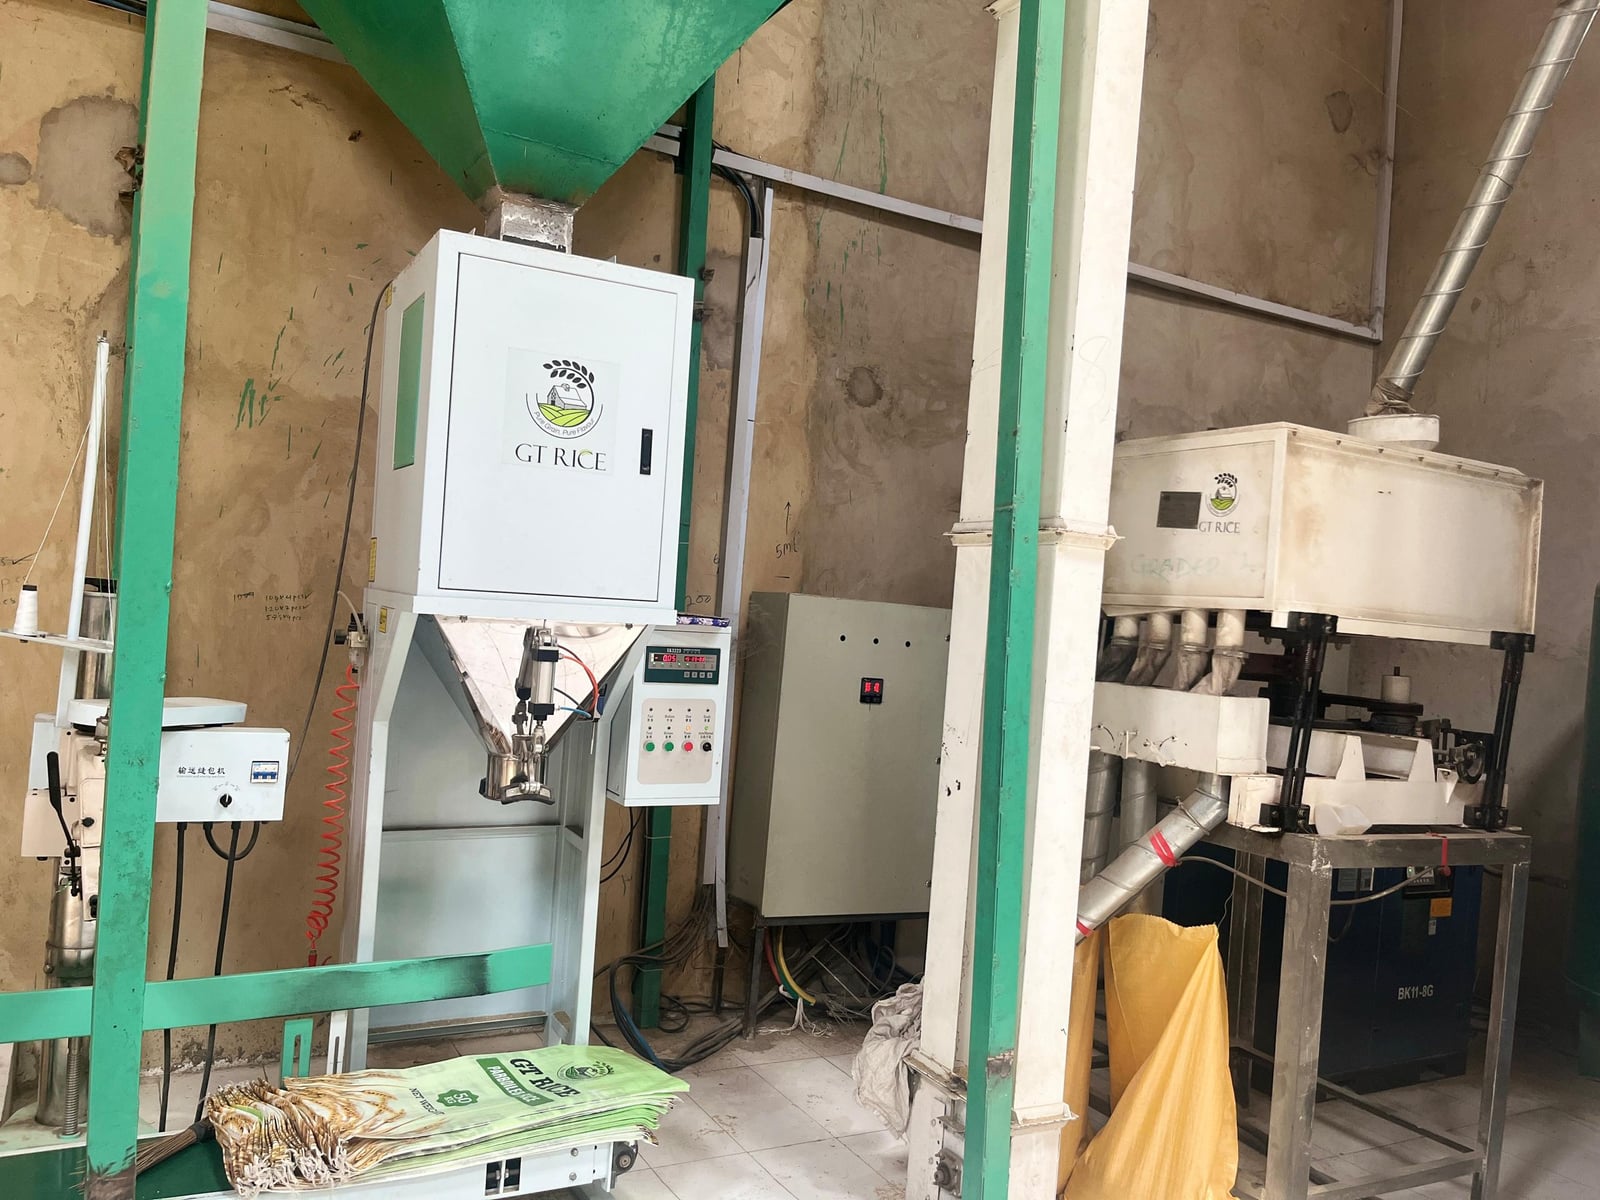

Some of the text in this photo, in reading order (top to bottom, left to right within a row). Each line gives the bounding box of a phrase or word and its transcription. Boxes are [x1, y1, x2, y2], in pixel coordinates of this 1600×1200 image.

[515, 443, 607, 471] GT RICE
[1215, 521, 1240, 534] RICE
[1398, 984, 1434, 1000] BK11-8G
[510, 1058, 544, 1075] GT
[529, 1076, 580, 1098] RICE
[453, 1092, 473, 1104] 50
